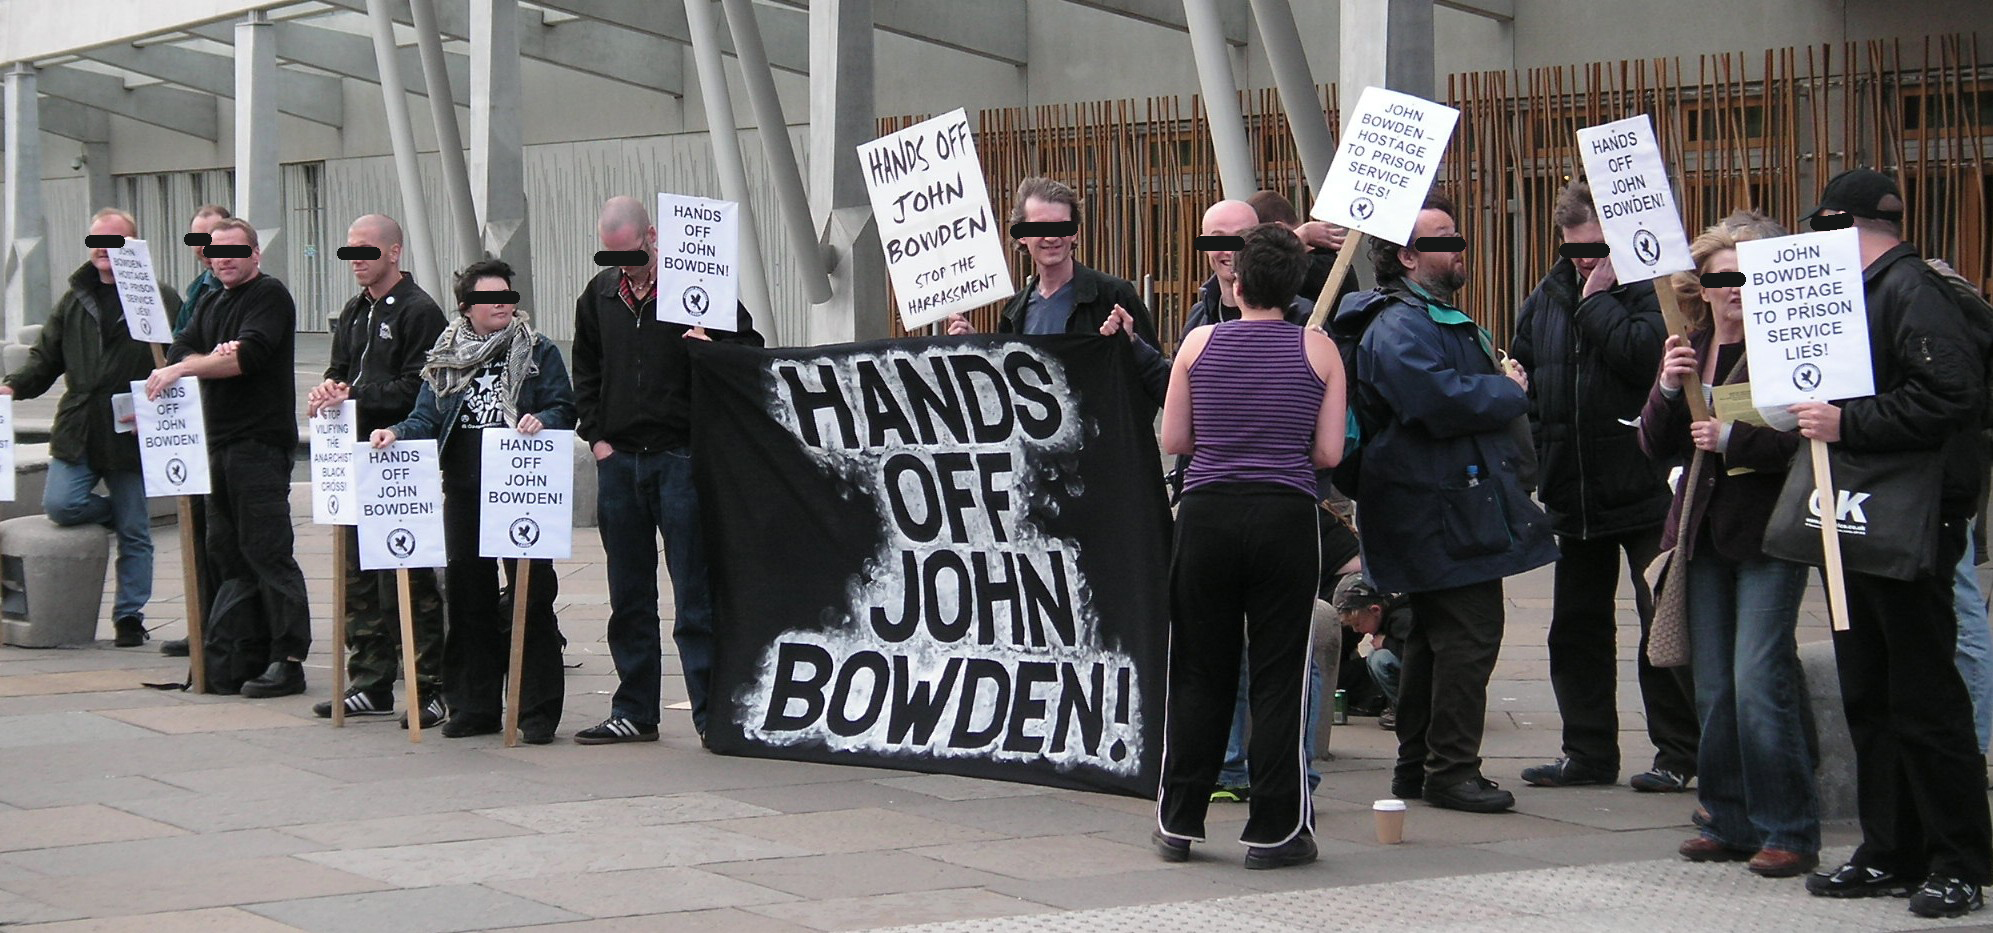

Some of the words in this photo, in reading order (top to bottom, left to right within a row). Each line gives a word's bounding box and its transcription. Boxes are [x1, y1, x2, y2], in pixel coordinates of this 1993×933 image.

[1385, 103, 1424, 122] JOHN
[1361, 113, 1424, 140] BOWDEN
[1358, 129, 1427, 158] HOSTAGE
[1592, 131, 1638, 154] HANDS
[868, 135, 929, 187] HANDS
[936, 120, 967, 161] OFF
[1347, 143, 1365, 157] TO
[1371, 150, 1425, 175] PRISON
[1608, 155, 1633, 173] OFF
[1348, 161, 1410, 188] SERVICE
[1354, 180, 1390, 200] LIES!
[1611, 175, 1646, 196] JOHN
[892, 171, 965, 224] JOHN
[1602, 193, 1666, 219] BOWDEN!
[674, 205, 722, 222] HANDS
[684, 224, 711, 238] OFF
[886, 205, 988, 265] BOWDEN
[678, 241, 716, 257] JOHN
[1773, 245, 1820, 263] JOHN
[113, 257, 142, 269] BOWDEN
[664, 257, 729, 277] BOWDEN!
[915, 266, 946, 289] STOP
[950, 255, 976, 275] THE
[1752, 263, 1830, 286] BOWDEN
[118, 281, 128, 290] TO
[130, 282, 155, 293] PRISON
[908, 273, 998, 316] HARRASSMENT
[1758, 281, 1843, 304] HOSTAGE
[126, 293, 155, 305] SERVICE
[1753, 310, 1777, 325] TO
[1787, 300, 1852, 321] PRISON
[1767, 321, 1843, 343] SERVICE
[1785, 343, 1829, 360] LIES!
[155, 387, 186, 399] ANDS
[779, 350, 1062, 449] HANDS
[157, 403, 180, 415] OFF
[155, 419, 186, 431] JOHN
[316, 424, 349, 434] VILIFYING
[145, 434, 199, 448] BOWDEN!
[326, 438, 340, 448] THE
[500, 439, 554, 452] HANDS
[314, 452, 353, 463] ANARCHIST
[369, 450, 421, 464] HANDS
[511, 456, 542, 469] OFF
[322, 467, 346, 477] BLACK
[381, 468, 410, 480] OFF
[504, 474, 547, 487] JOHN
[321, 482, 347, 492] CROSS!
[377, 485, 418, 498] JOHN
[488, 491, 563, 505] BOWDEN!
[883, 452, 1013, 545] OFF
[363, 502, 434, 516] BOWDEN!
[869, 549, 1077, 648] JOHN
[761, 641, 1130, 763] BOWDEN!
